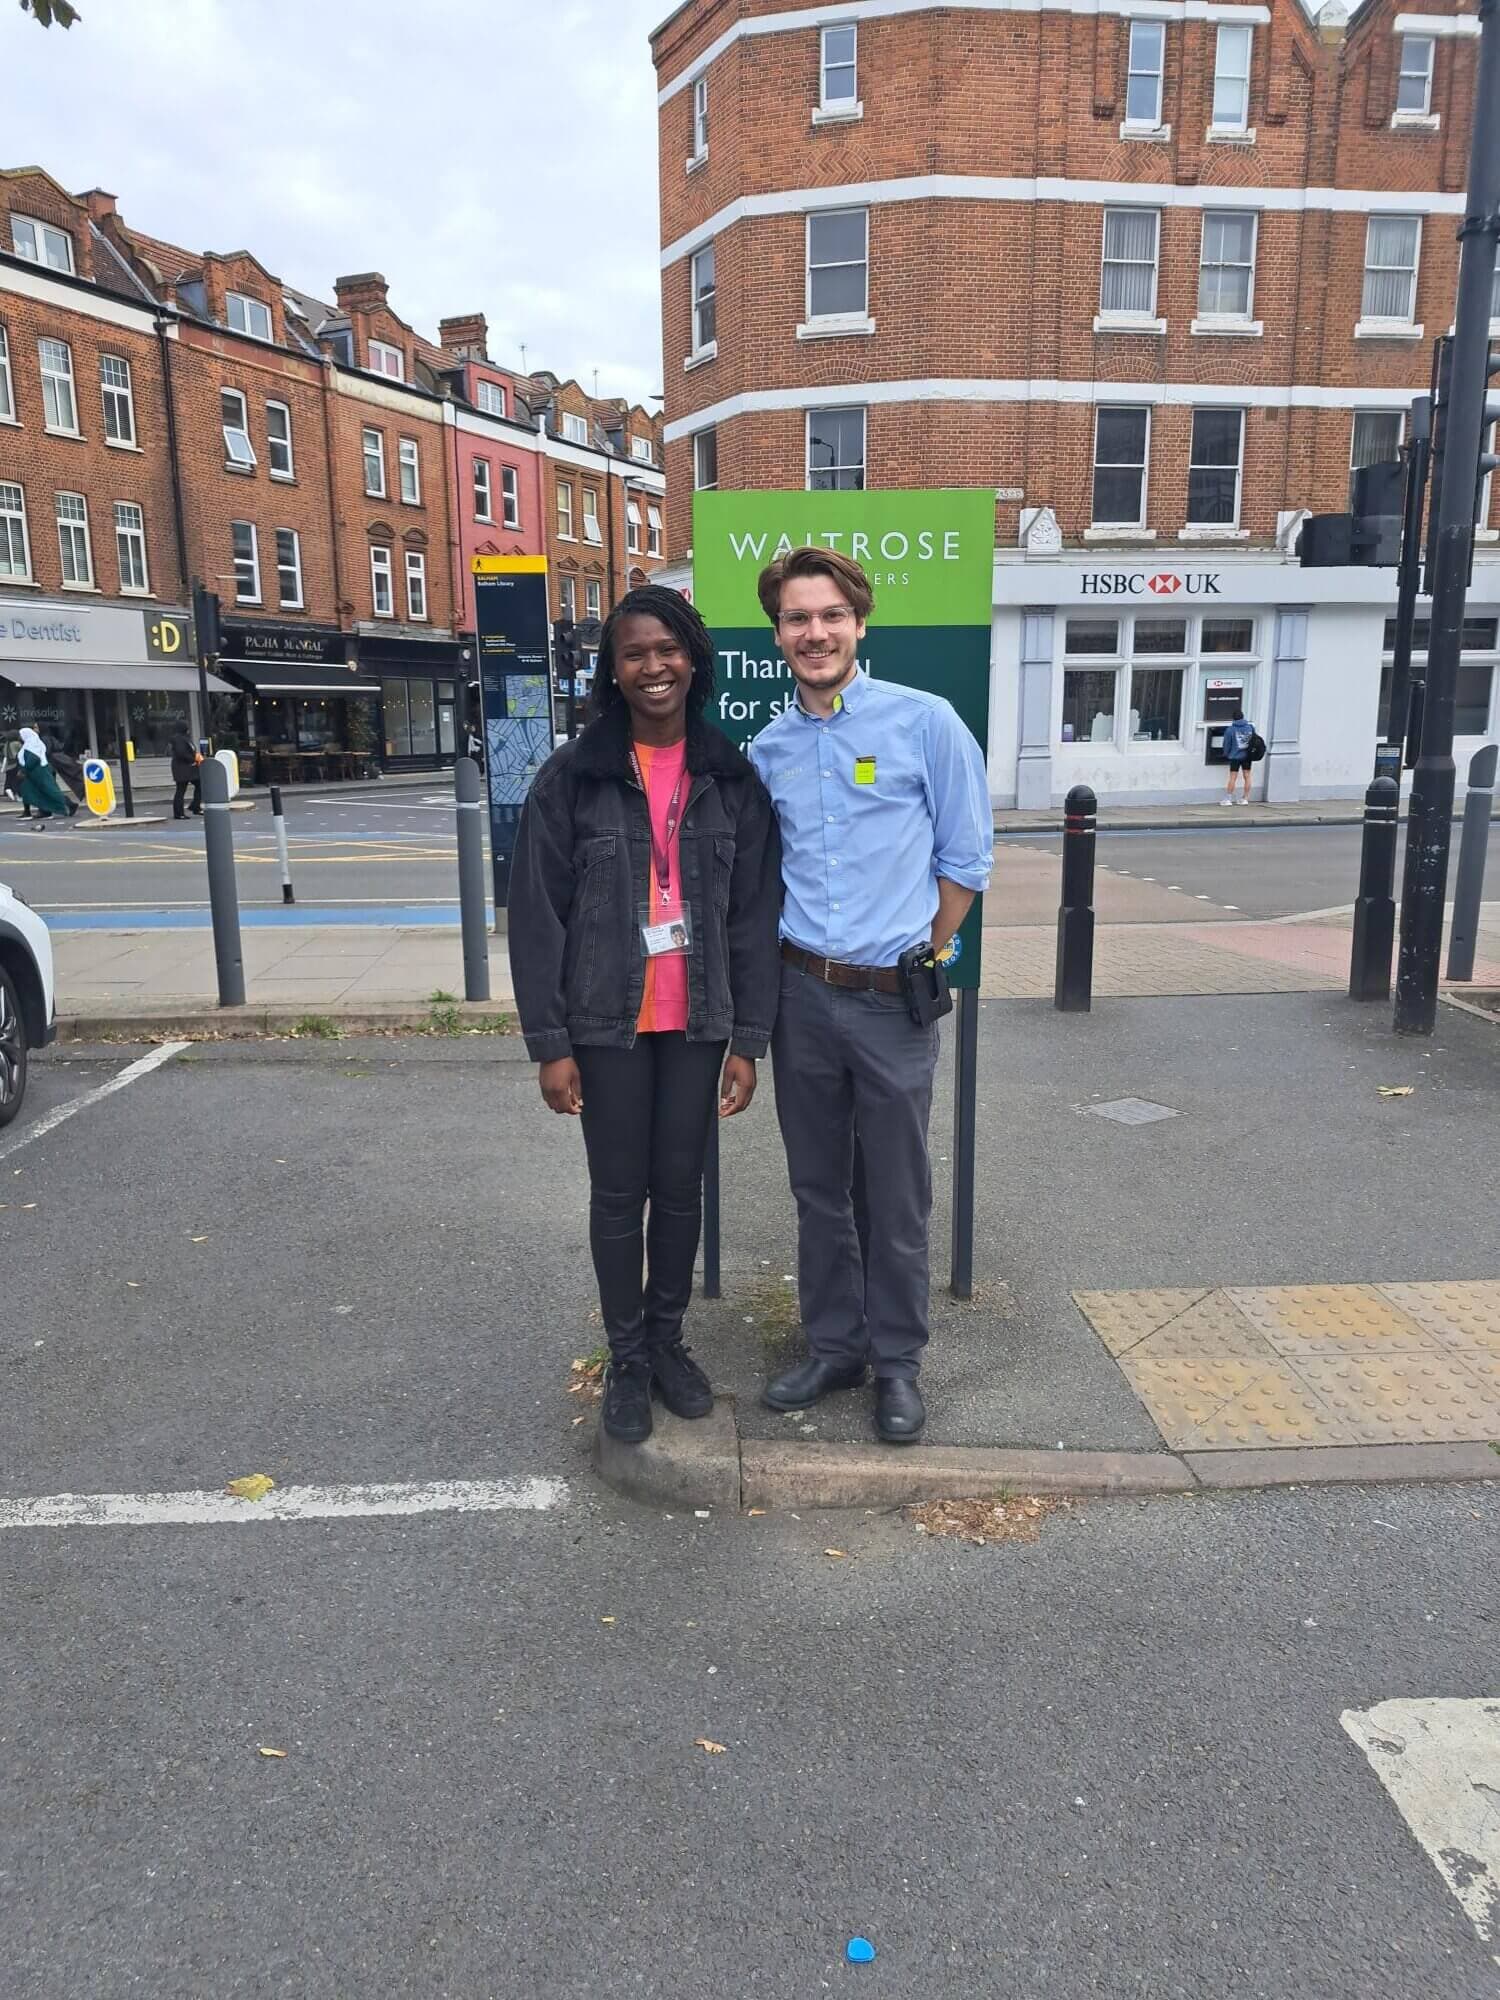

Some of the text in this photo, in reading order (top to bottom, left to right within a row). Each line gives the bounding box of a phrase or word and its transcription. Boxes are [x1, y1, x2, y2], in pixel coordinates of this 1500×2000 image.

[728, 531, 960, 561] WAITROSE
[1080, 574, 1222, 594] HSBC UK
[11, 618, 82, 643] Dentist
[718, 650, 793, 679] Than
[718, 692, 761, 720] for
